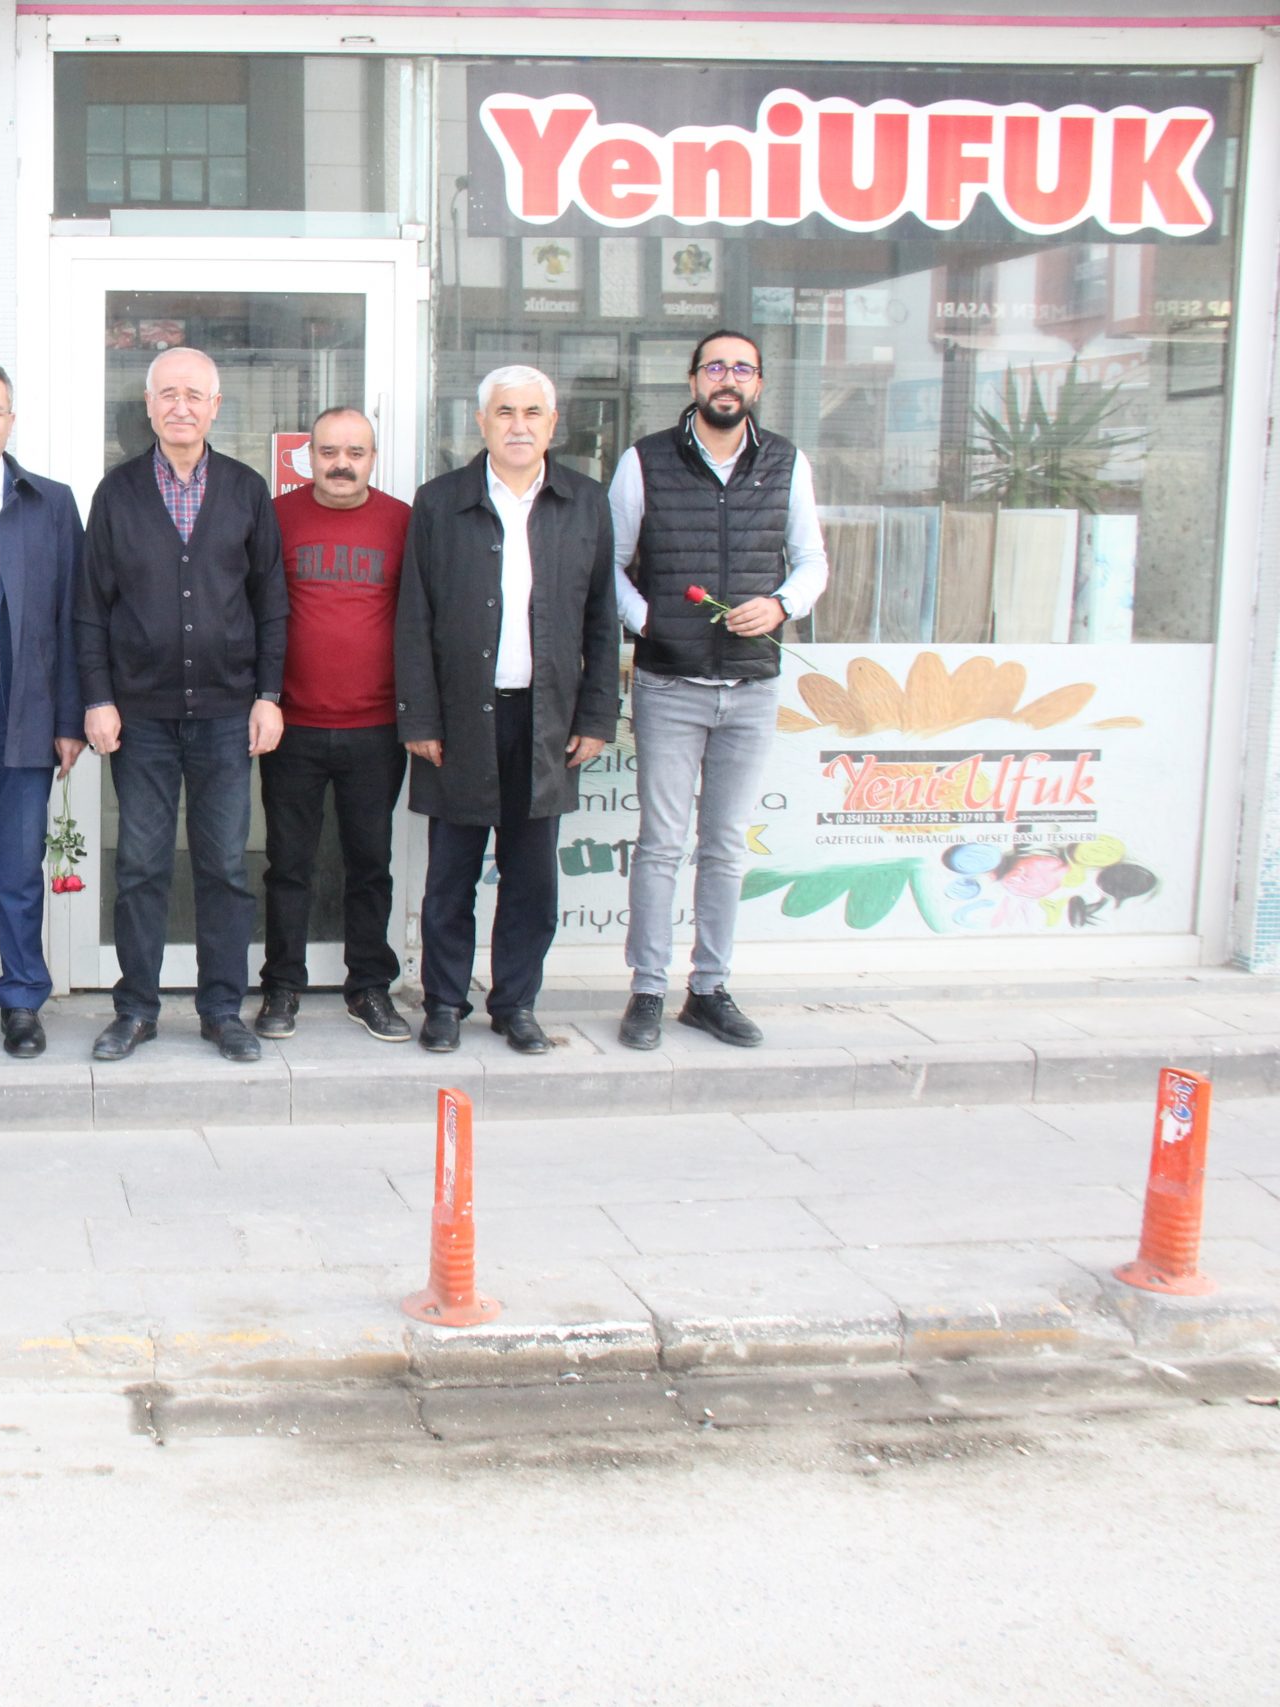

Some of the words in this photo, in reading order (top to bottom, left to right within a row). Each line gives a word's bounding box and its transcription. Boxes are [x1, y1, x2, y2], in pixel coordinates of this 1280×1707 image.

[487, 101, 1210, 226] YeniUFUK
[296, 543, 385, 585] BLACK
[822, 752, 940, 812] Yeni
[942, 751, 1098, 823] Ufuk
[976, 832, 1009, 843] OFSET
